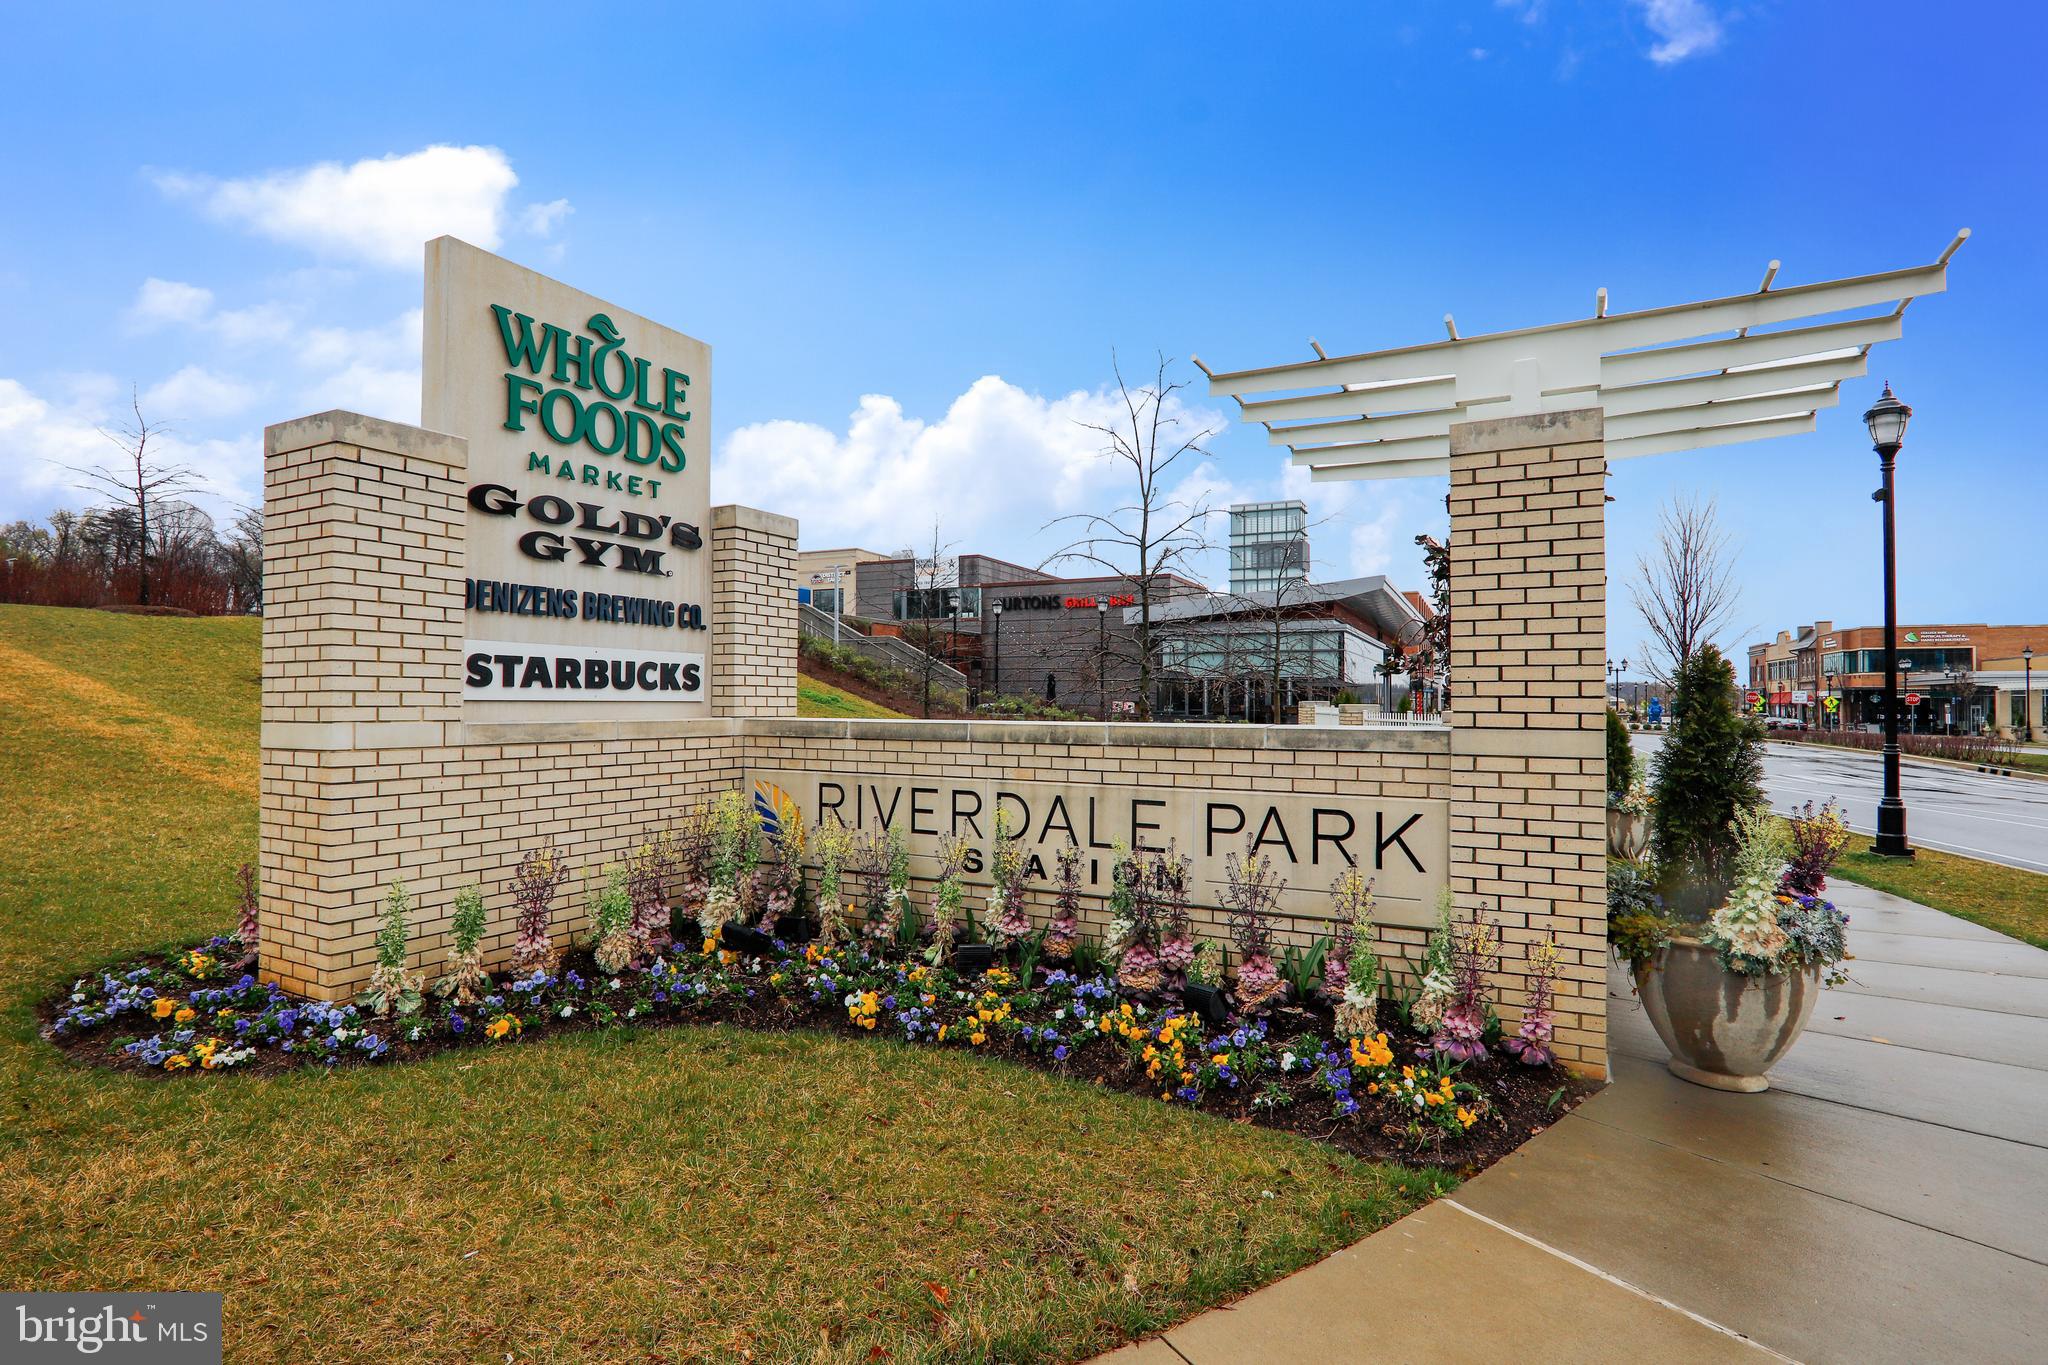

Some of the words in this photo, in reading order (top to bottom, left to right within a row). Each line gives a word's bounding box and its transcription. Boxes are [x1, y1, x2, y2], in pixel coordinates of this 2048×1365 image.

[490, 303, 692, 422] WHOLE
[503, 373, 687, 472] FOODS
[528, 451, 662, 499] MARKET
[467, 483, 703, 550] GOLD'S
[582, 591, 675, 628] BREWING
[679, 602, 707, 631] CO.
[1001, 594, 1061, 612] URTONS
[1064, 596, 1098, 609] GRILL
[465, 653, 701, 692] STARBUCKS
[818, 782, 1167, 854] RIVERDALE
[1206, 803, 1426, 873] PARK
